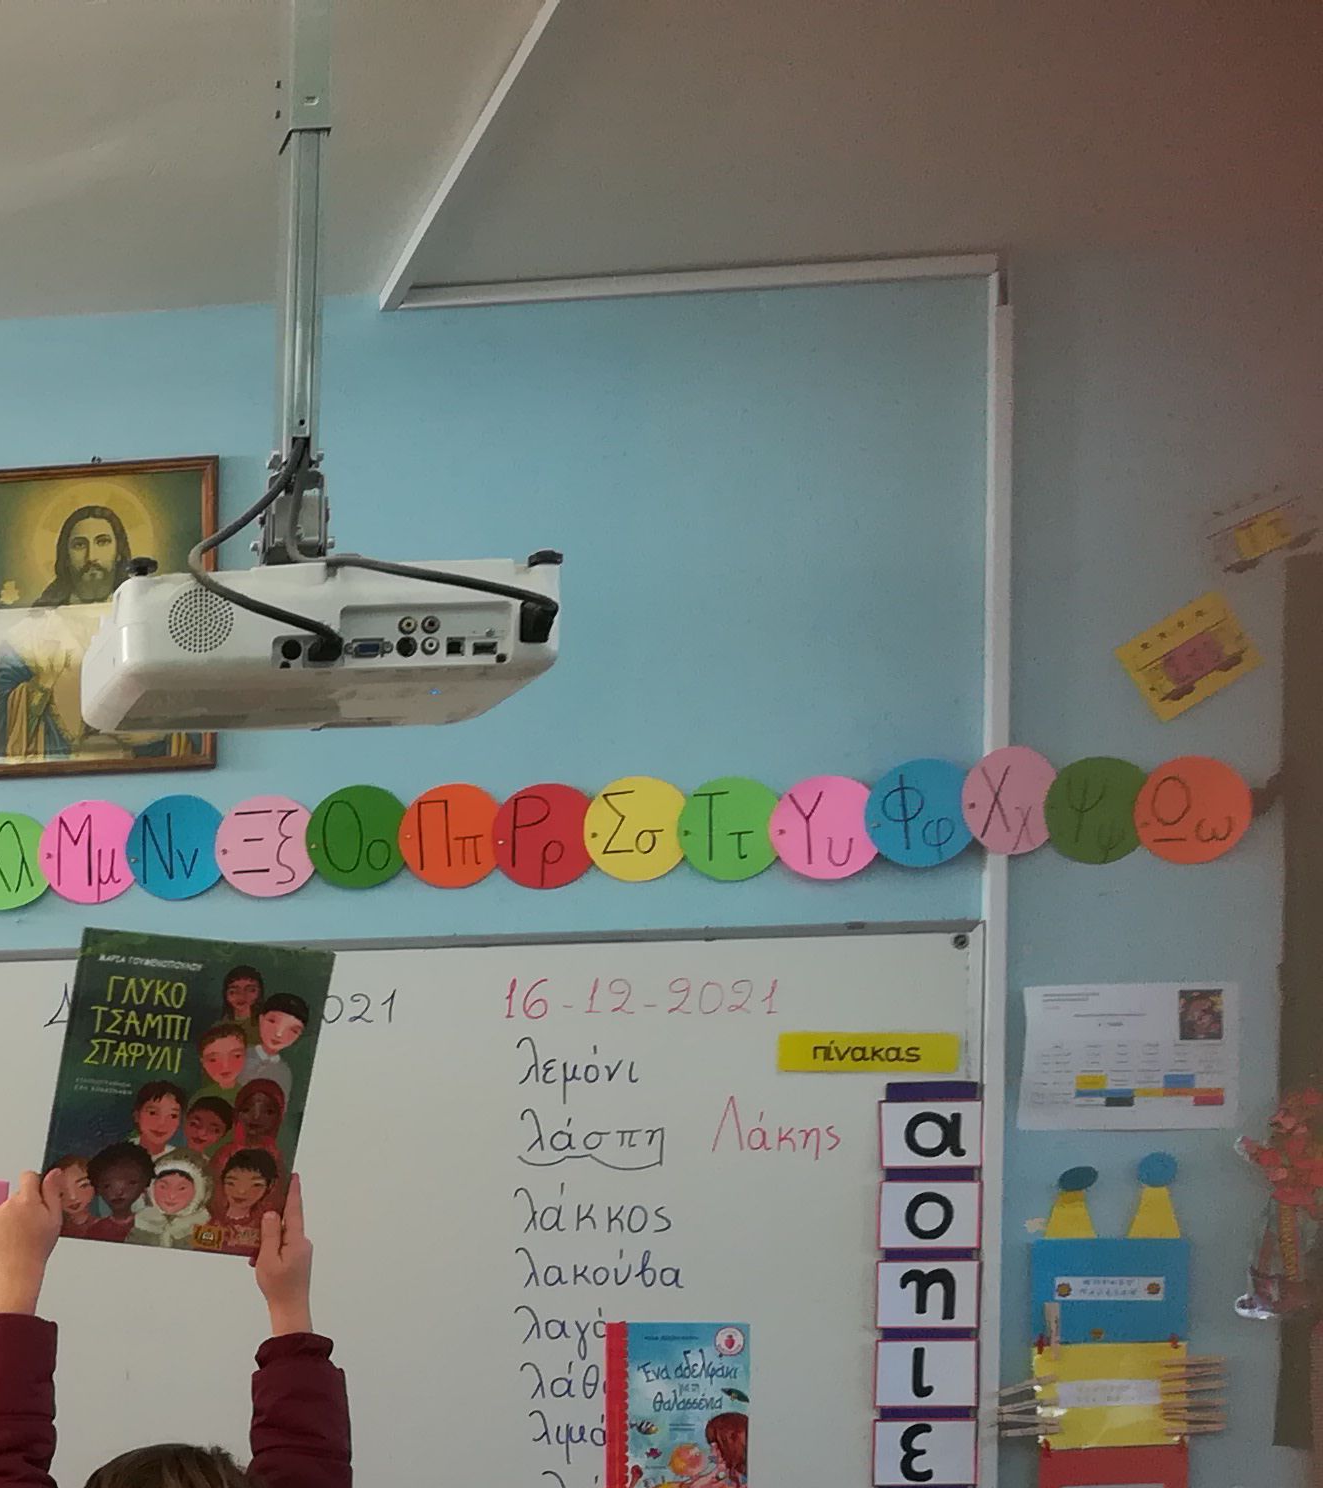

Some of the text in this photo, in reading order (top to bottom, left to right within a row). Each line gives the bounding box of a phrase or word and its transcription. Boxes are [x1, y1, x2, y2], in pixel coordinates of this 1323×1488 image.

[107, 976, 187, 1009] ΓΛΥΚΟ
[322, 989, 397, 1025] 021
[91, 1006, 192, 1041] ΤΣΑΜΠΙ
[83, 1039, 182, 1074] ΣΤΑΦΥΛΙ
[517, 1036, 639, 1104] λεμόνι
[812, 1039, 921, 1063] πίνακας
[520, 1108, 665, 1165] λάσπη
[712, 1095, 841, 1160] Λάκης
[904, 1111, 966, 1158] α
[514, 1182, 672, 1233] λάκκος
[515, 1247, 684, 1289] λακούβα
[899, 1267, 956, 1321] η
[514, 1305, 605, 1361] λαγό
[520, 1361, 605, 1400] λάθ
[900, 1422, 934, 1483] ε
